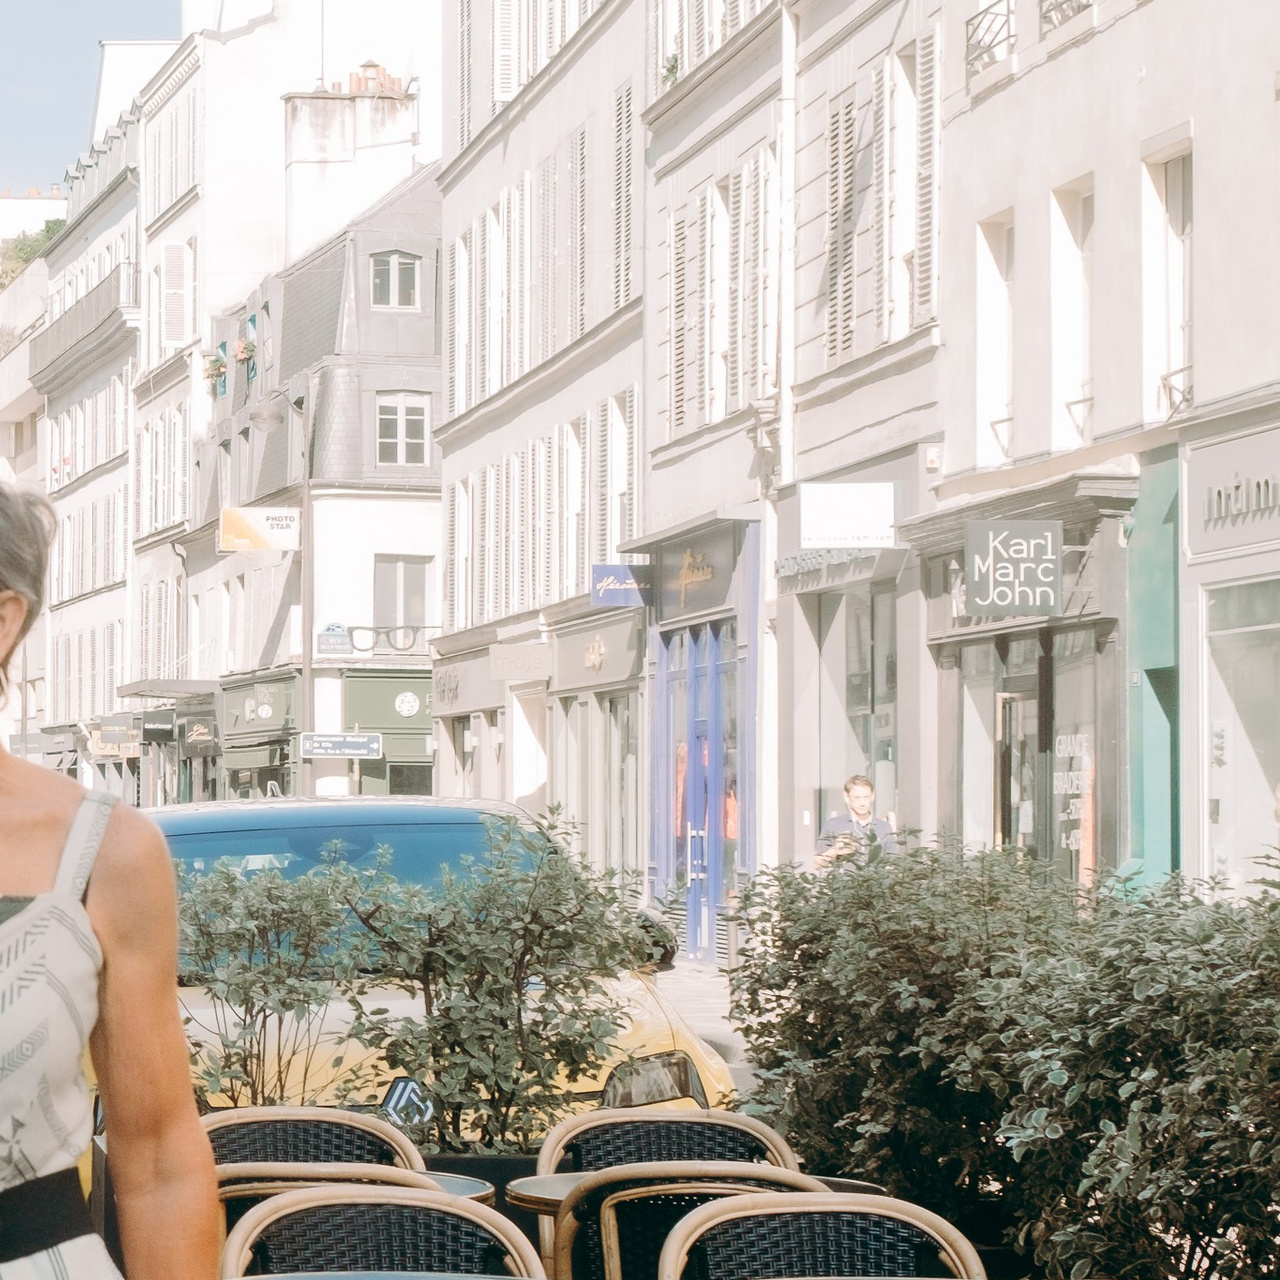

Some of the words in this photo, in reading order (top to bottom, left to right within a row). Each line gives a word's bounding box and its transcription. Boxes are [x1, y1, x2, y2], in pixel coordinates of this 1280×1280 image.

[989, 530, 1057, 560] Karl
[974, 554, 1055, 582] Marc
[974, 578, 1055, 607] John
[494, 653, 544, 672] maje
